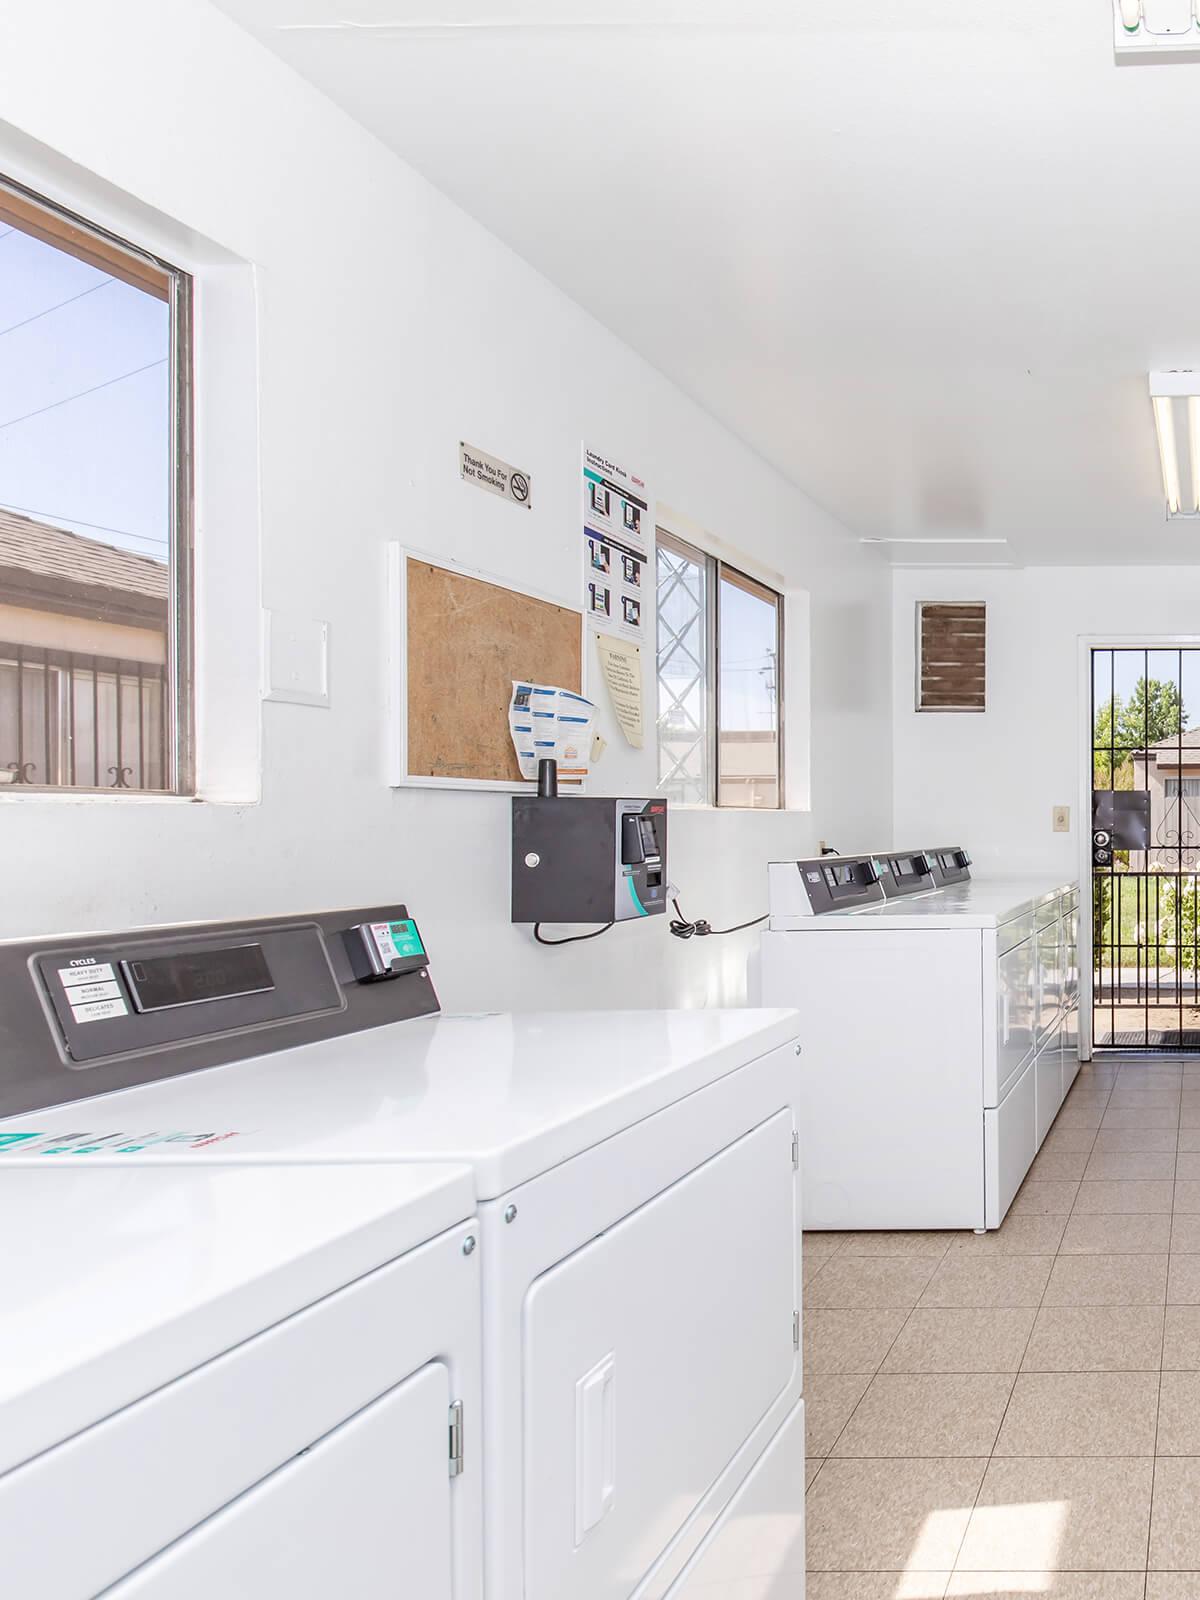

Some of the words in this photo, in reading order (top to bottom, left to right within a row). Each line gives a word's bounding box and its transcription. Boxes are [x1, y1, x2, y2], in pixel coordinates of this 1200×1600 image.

[464, 452, 484, 470] Thank
[485, 462, 497, 476] You
[497, 470, 508, 481] For
[586, 450, 604, 465] Laundry
[605, 460, 615, 470] Card
[586, 456, 613, 476] Instructions
[463, 464, 476, 477] Not
[477, 470, 505, 492] Smoking
[69, 957, 96, 966] CYCLES
[84, 1003, 115, 1013] DELICATES
